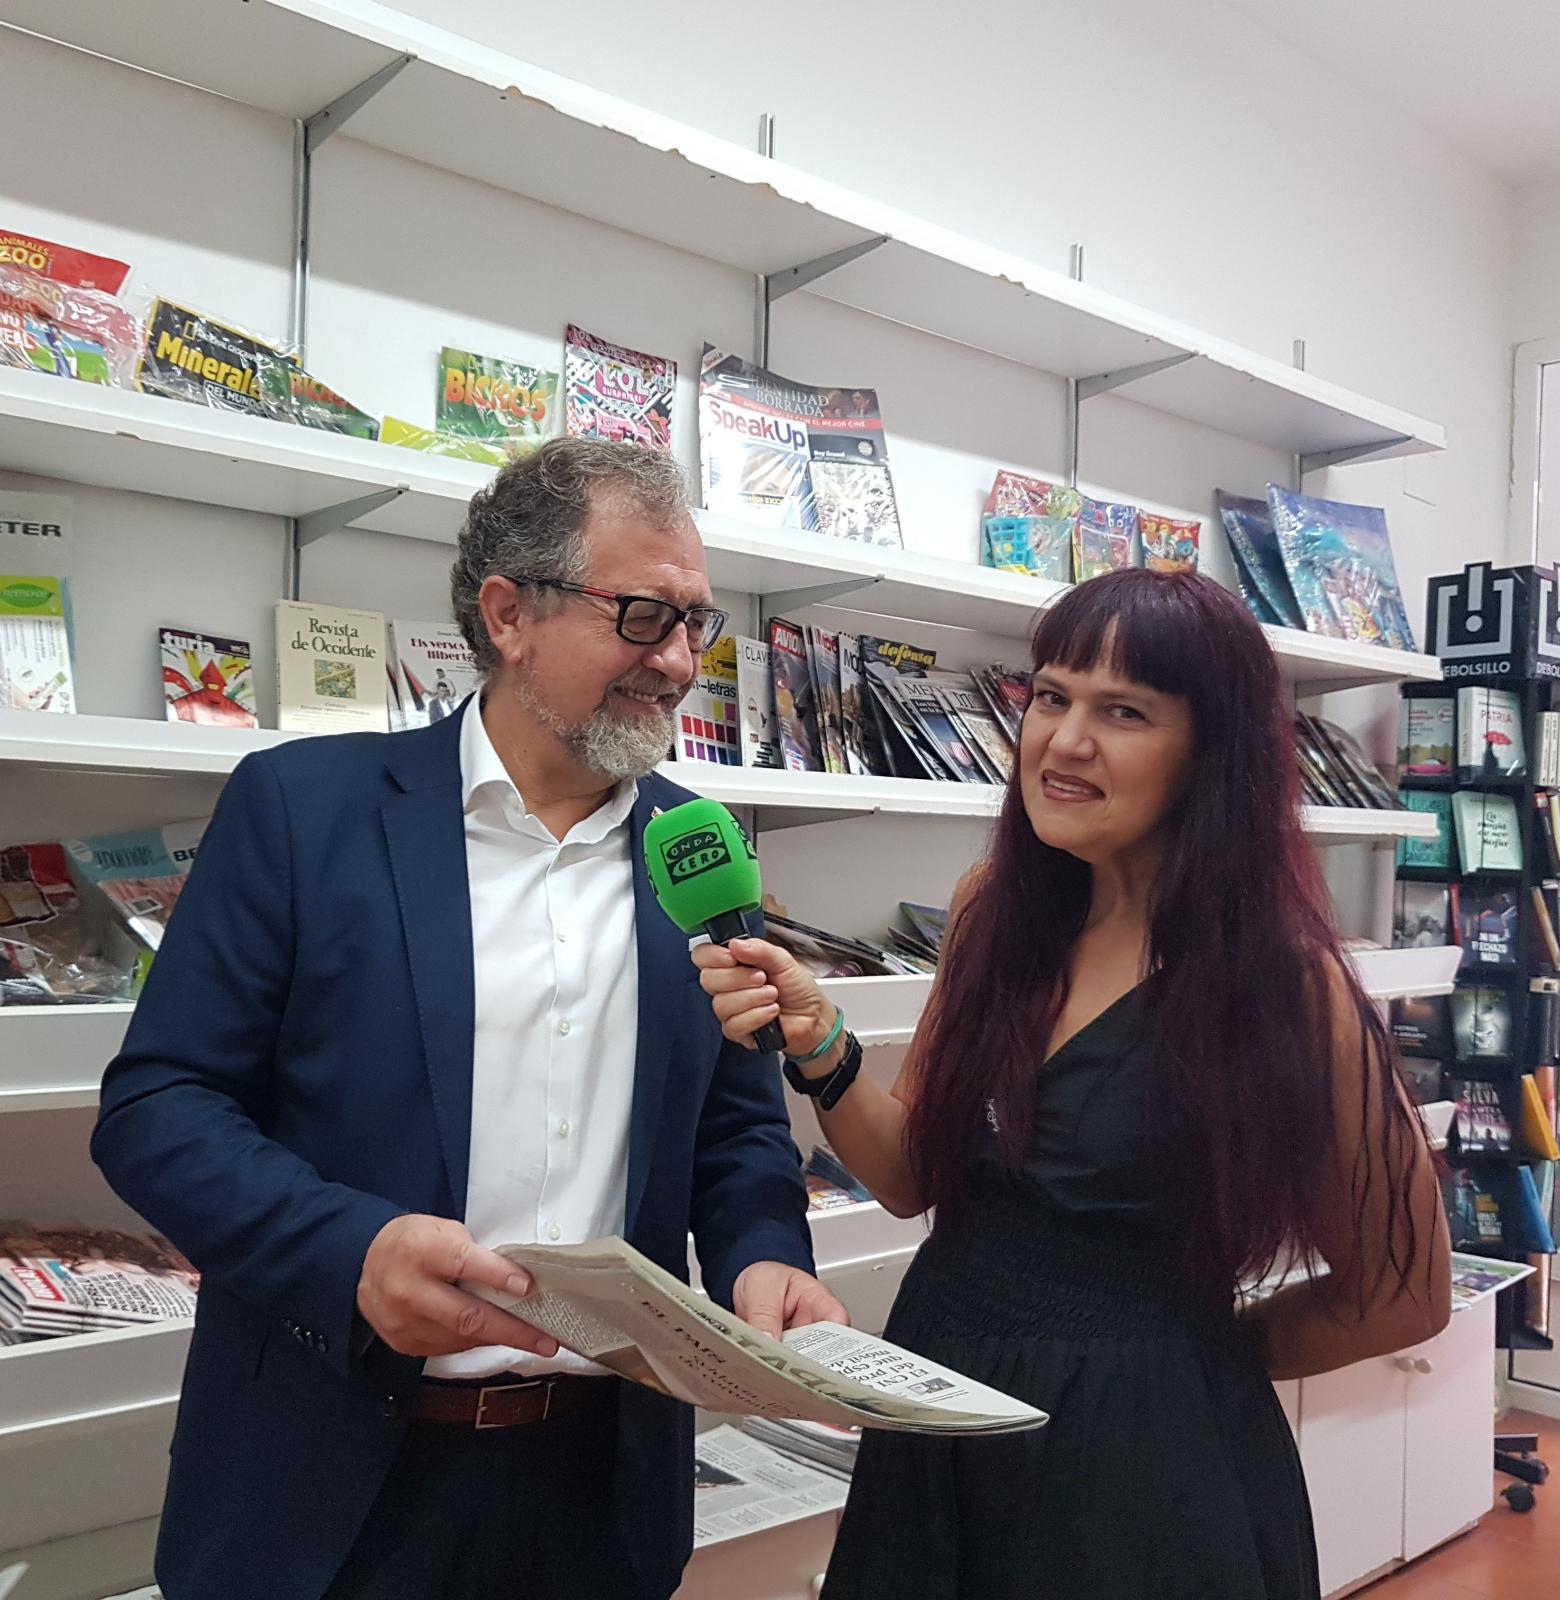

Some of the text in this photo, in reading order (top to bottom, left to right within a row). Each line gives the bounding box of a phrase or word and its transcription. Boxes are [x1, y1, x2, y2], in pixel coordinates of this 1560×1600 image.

[207, 382, 226, 398] DEL
[756, 389, 825, 418] BORRADA
[309, 617, 359, 638] Revista
[162, 631, 216, 655] turia
[291, 630, 377, 659] de Occidente
[878, 641, 934, 666] defensa
[1480, 709, 1513, 724] PATRIA
[671, 834, 714, 857] ONDA
[678, 849, 719, 873] CERO
[847, 1349, 891, 1364] móvil
[872, 1355, 903, 1366] que
[889, 1361, 915, 1373] del
[876, 1368, 929, 1388] El CNI
